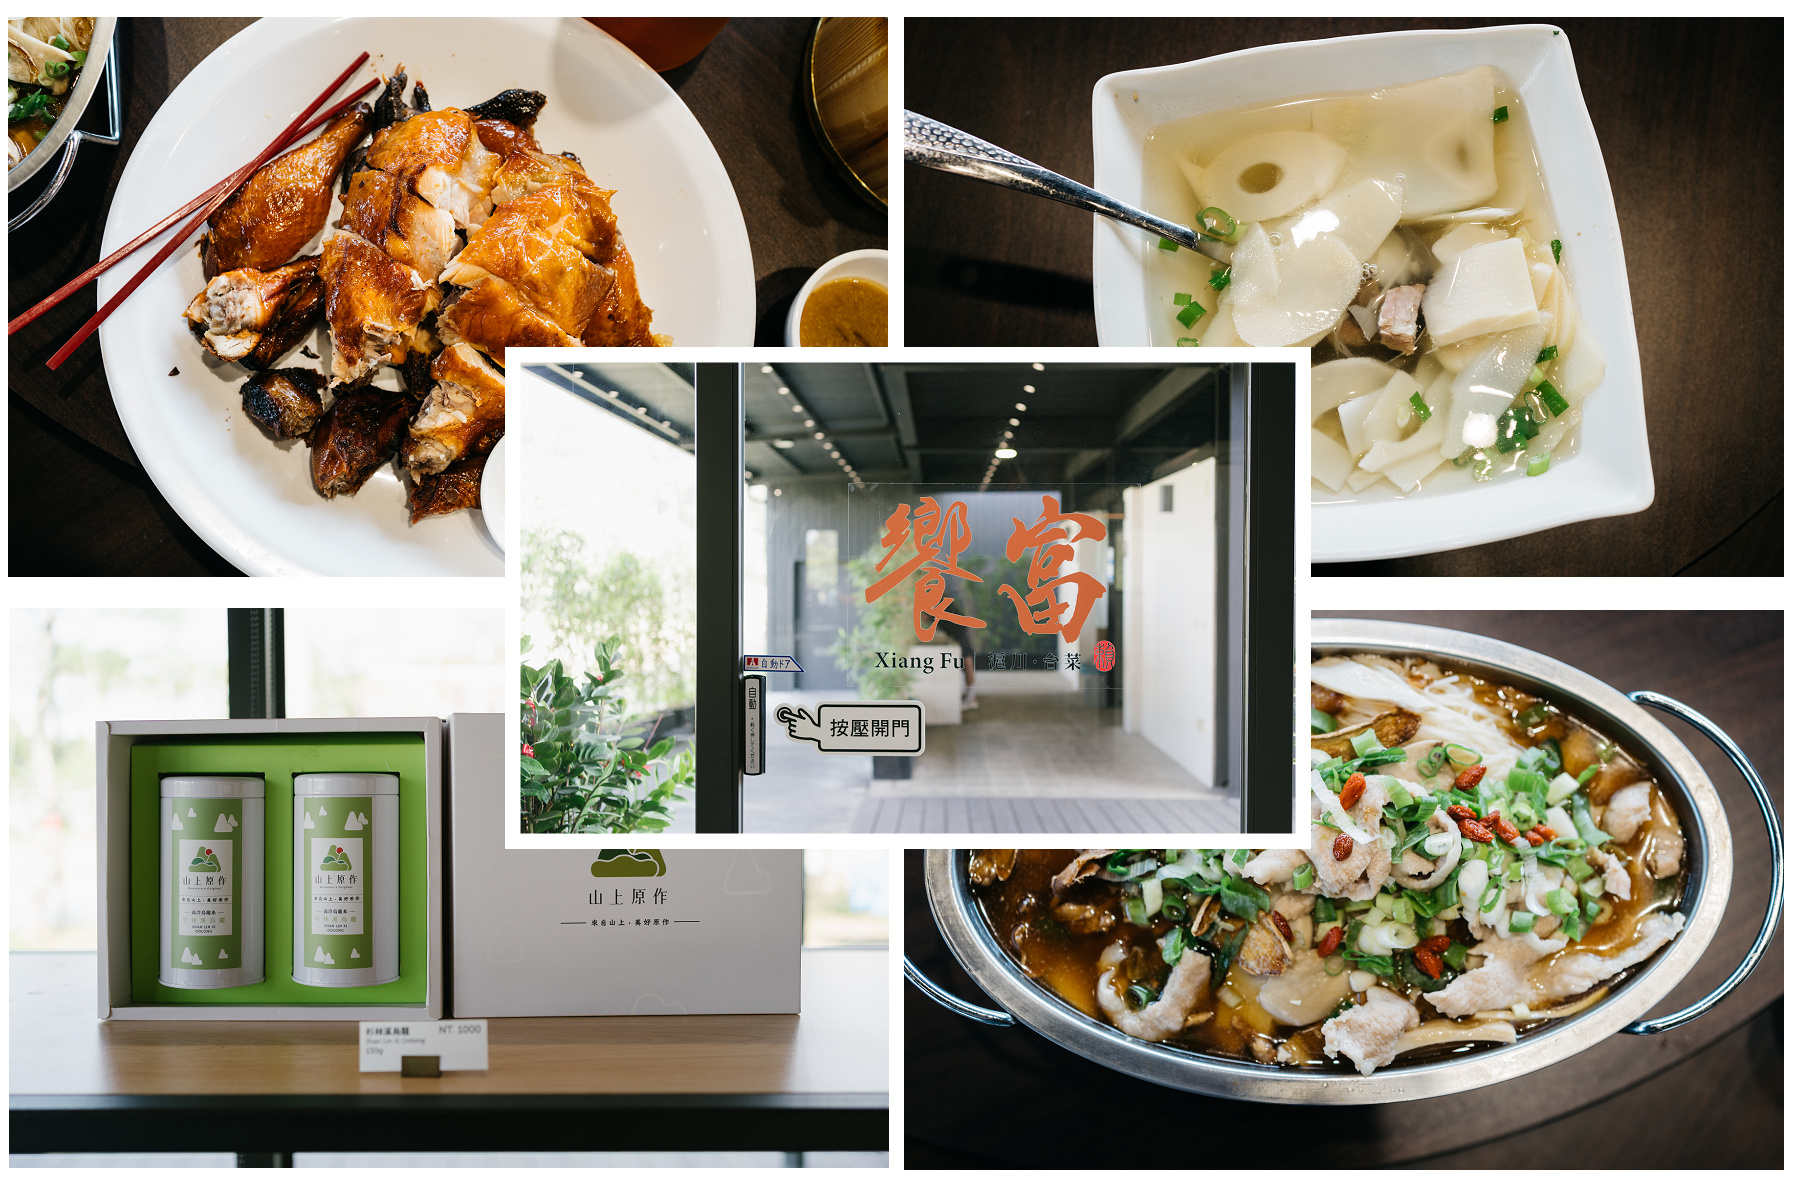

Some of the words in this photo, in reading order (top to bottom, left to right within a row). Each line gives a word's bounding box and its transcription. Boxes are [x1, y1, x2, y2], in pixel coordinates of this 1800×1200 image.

[865, 495, 1107, 643] 饗富
[761, 658, 791, 669] 自動ドア
[874, 652, 934, 674] Xiang
[940, 652, 965, 669] Fu
[748, 687, 757, 710] 自動
[830, 719, 910, 738] 按壓開門
[182, 876, 227, 886] 山上原作
[315, 874, 358, 884] 山上原作
[589, 887, 668, 905] 山上原作
